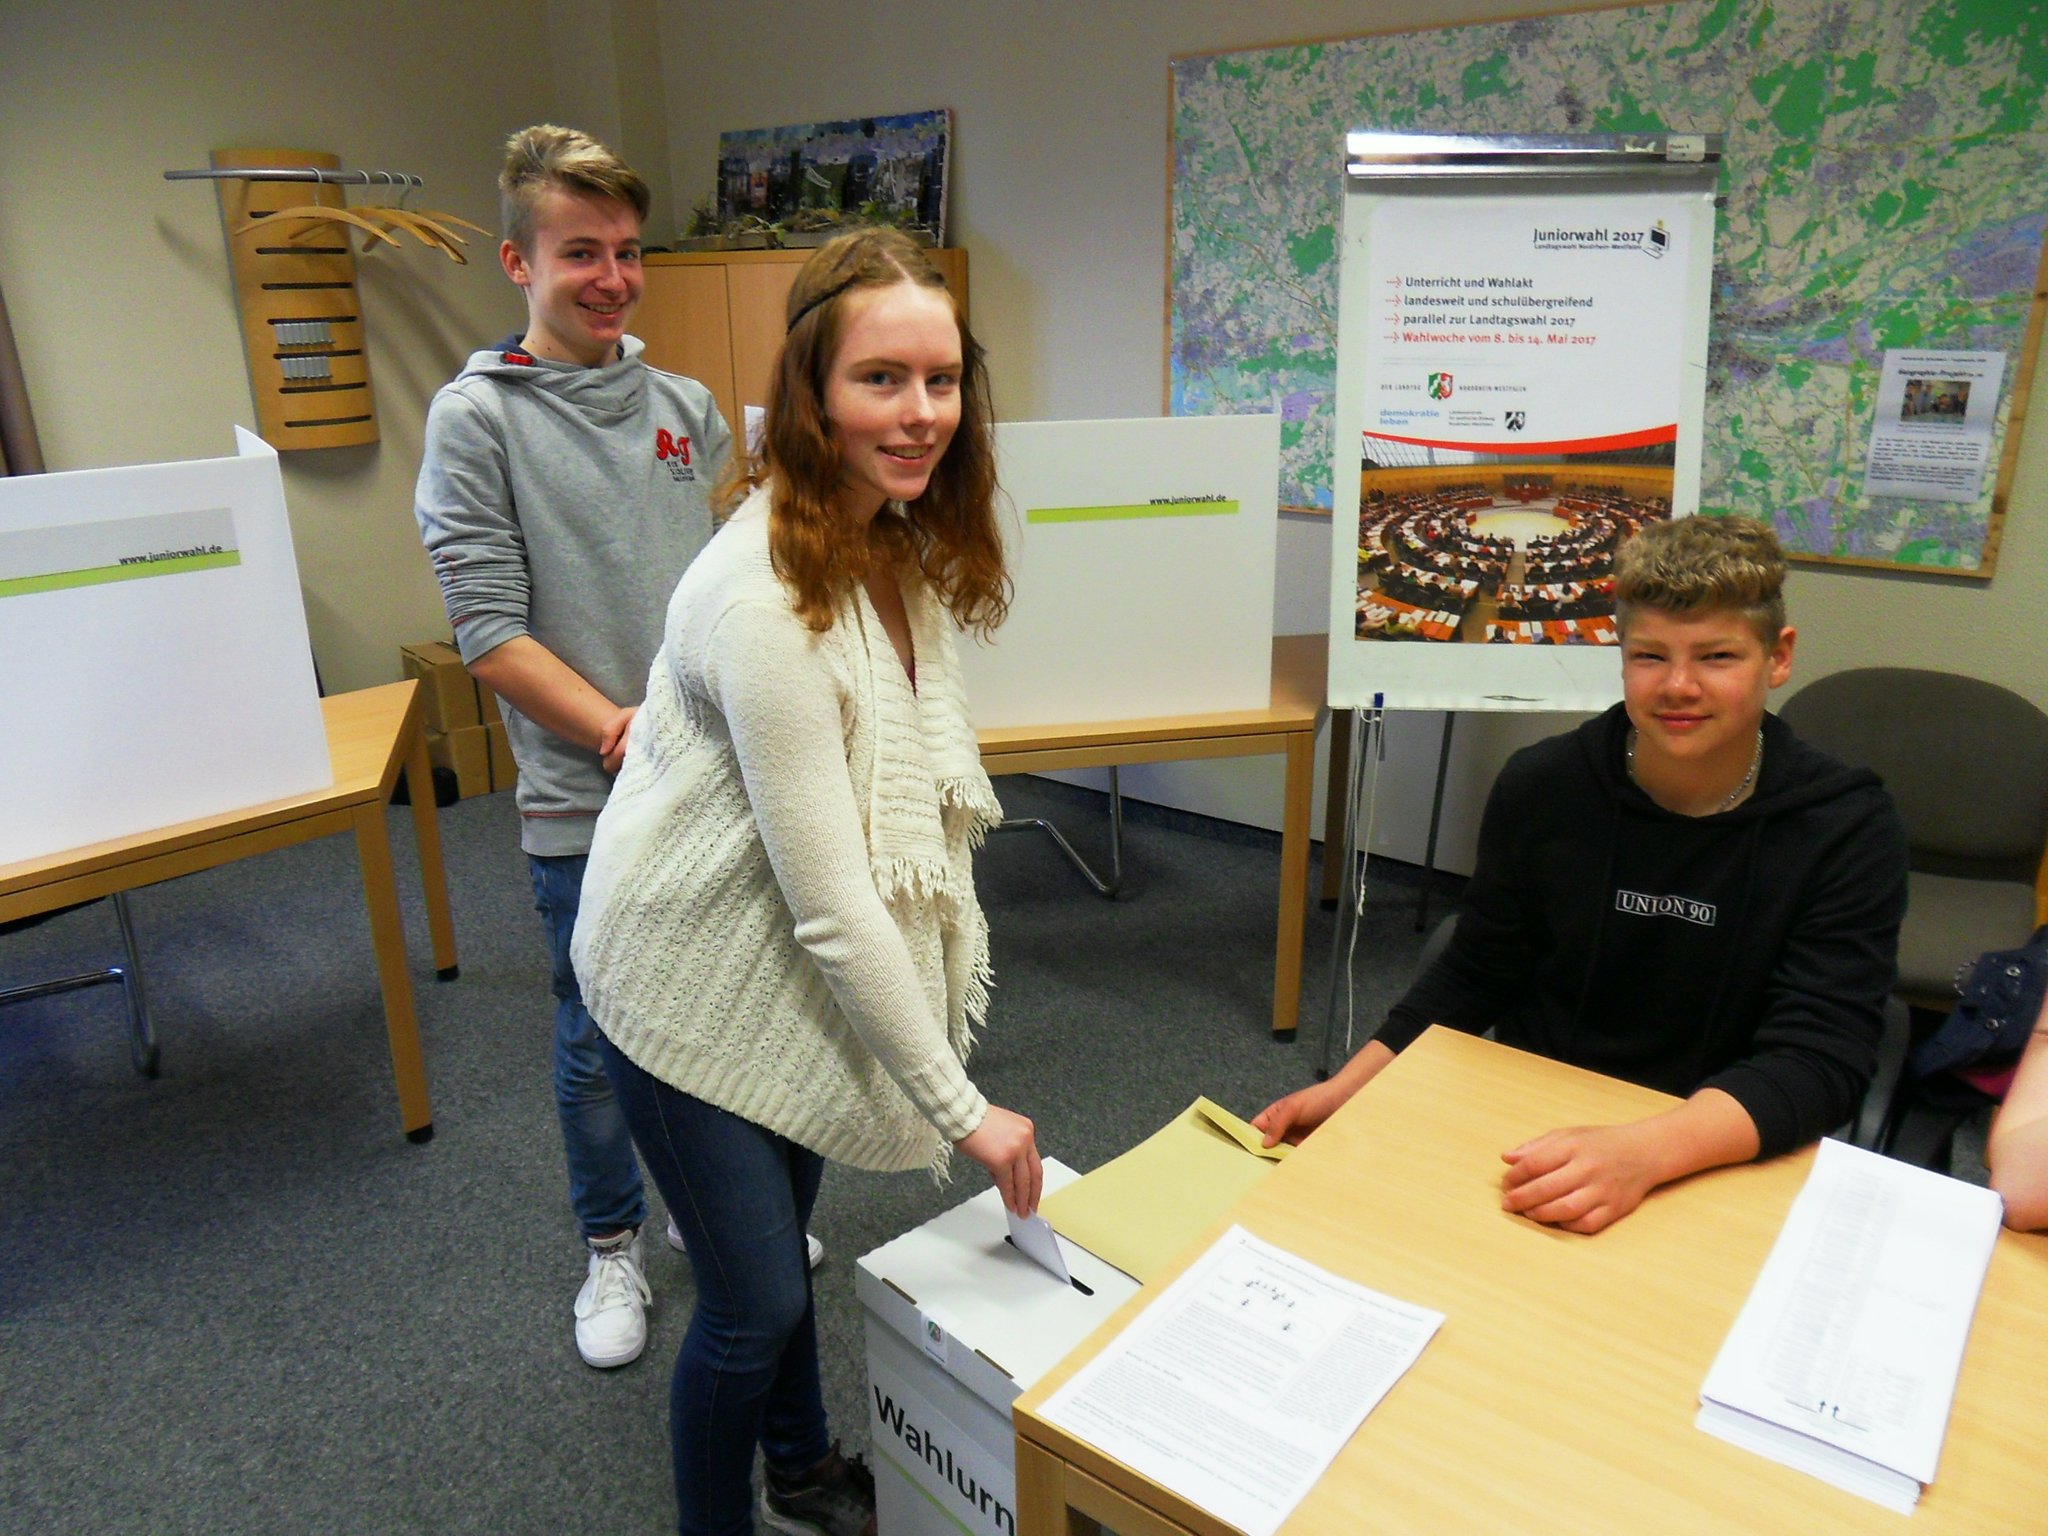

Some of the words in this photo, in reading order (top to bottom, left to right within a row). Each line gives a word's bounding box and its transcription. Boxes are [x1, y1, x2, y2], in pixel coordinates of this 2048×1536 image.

[1533, 228, 1608, 243] Juniorwahl
[1612, 232, 1645, 244] 2017
[1405, 276, 1461, 288] Unterricht
[1464, 277, 1485, 288] und
[1487, 277, 1534, 288] Wahlakt
[1404, 295, 1465, 306] landesweit
[1467, 296, 1489, 306] und
[1491, 296, 1593, 309] schulübergreifend
[1403, 314, 1447, 327] parallel
[1449, 317, 1467, 325] zur
[1469, 314, 1547, 327] Landtagswahl
[1550, 318, 1576, 328] 2017
[1402, 332, 1466, 343] Wahlwoche
[1468, 335, 1491, 343] vom
[1494, 333, 1505, 343] 8.
[1508, 333, 1525, 343] bis
[1528, 337, 1543, 345] 14.
[1547, 334, 1568, 344] Mai
[1571, 336, 1596, 345] 2017
[1380, 409, 1440, 417] demokratie
[1379, 417, 1408, 425] leben
[1149, 494, 1226, 505] www.juniorwahl.de
[118, 544, 222, 564] www.juniorwahl.de
[1622, 894, 1685, 914] UNION
[1689, 903, 1710, 922] 90
